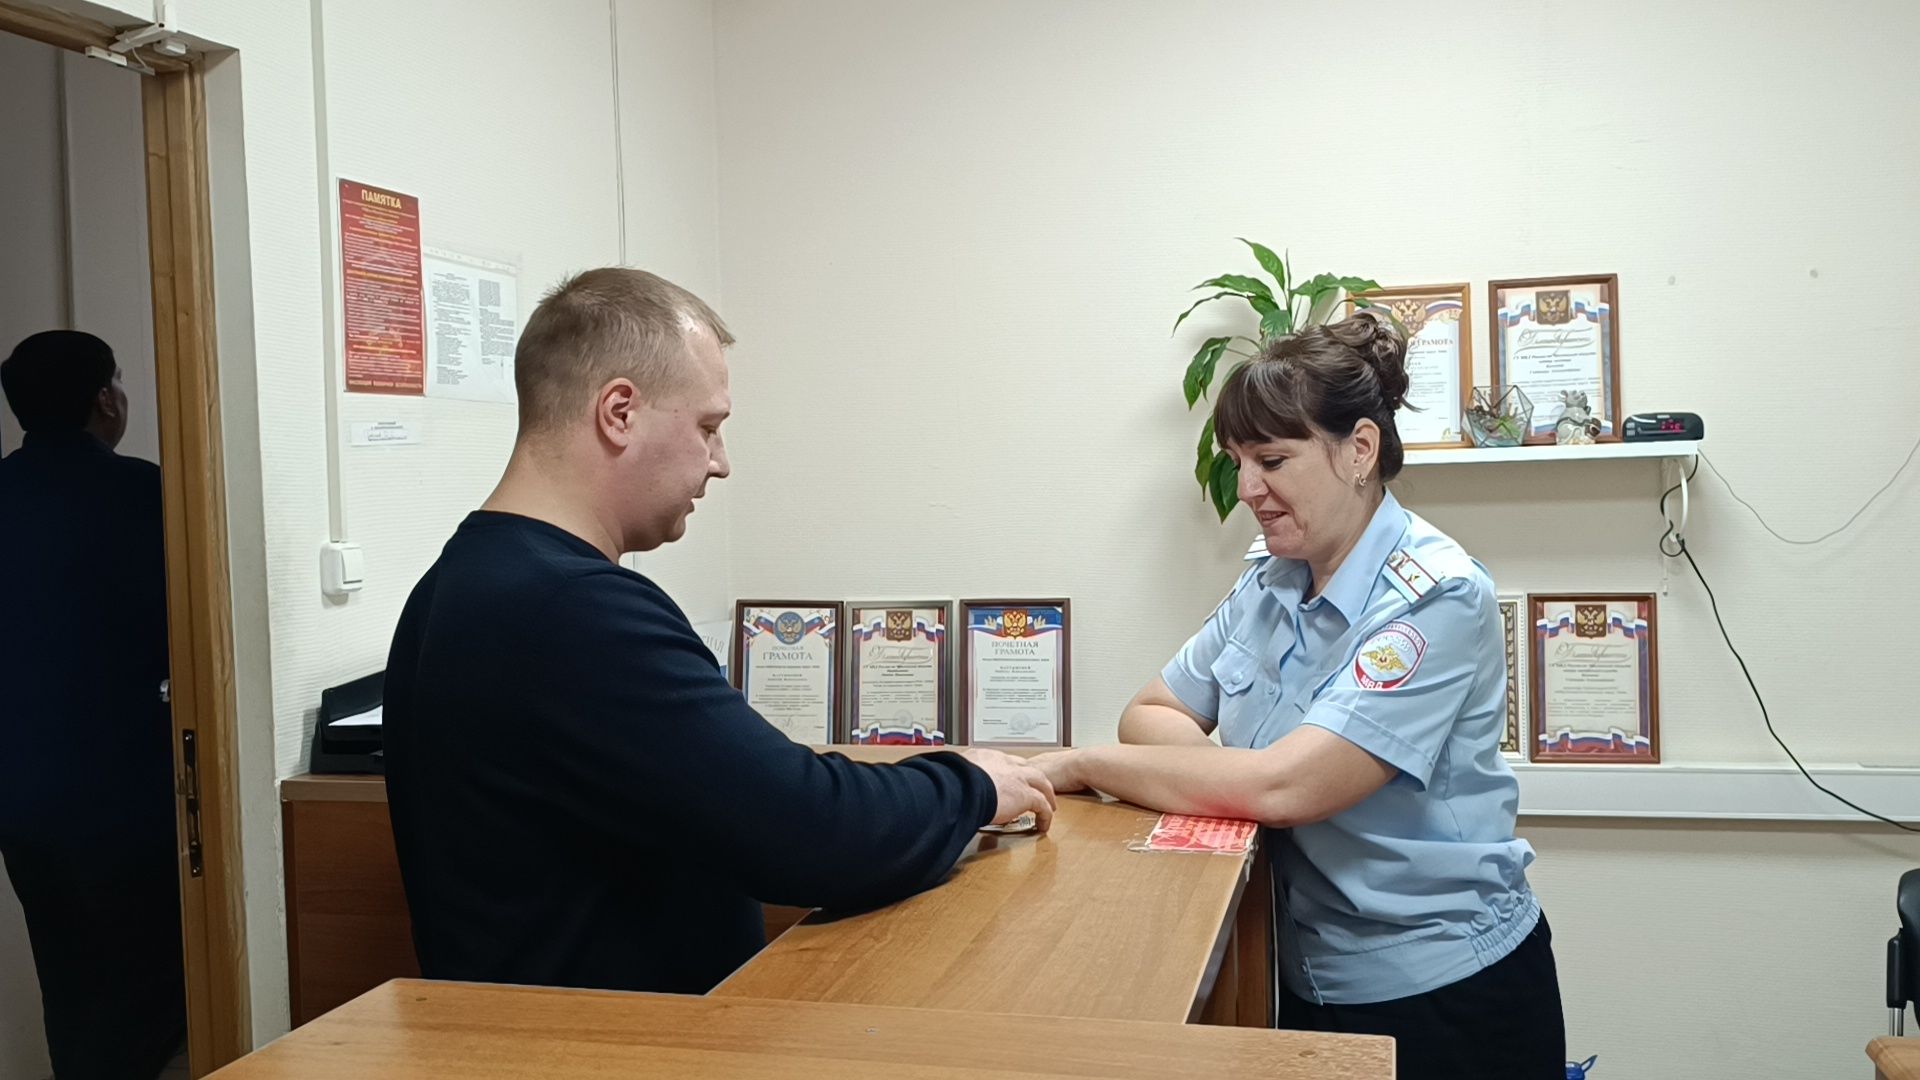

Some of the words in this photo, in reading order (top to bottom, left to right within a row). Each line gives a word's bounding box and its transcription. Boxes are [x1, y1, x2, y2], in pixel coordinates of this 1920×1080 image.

[361, 188, 402, 209] ПАМЯТКА
[762, 651, 813, 661] ГРАМОТА
[994, 648, 1036, 656] ГРАМОТА
[1360, 674, 1384, 689] МВД
